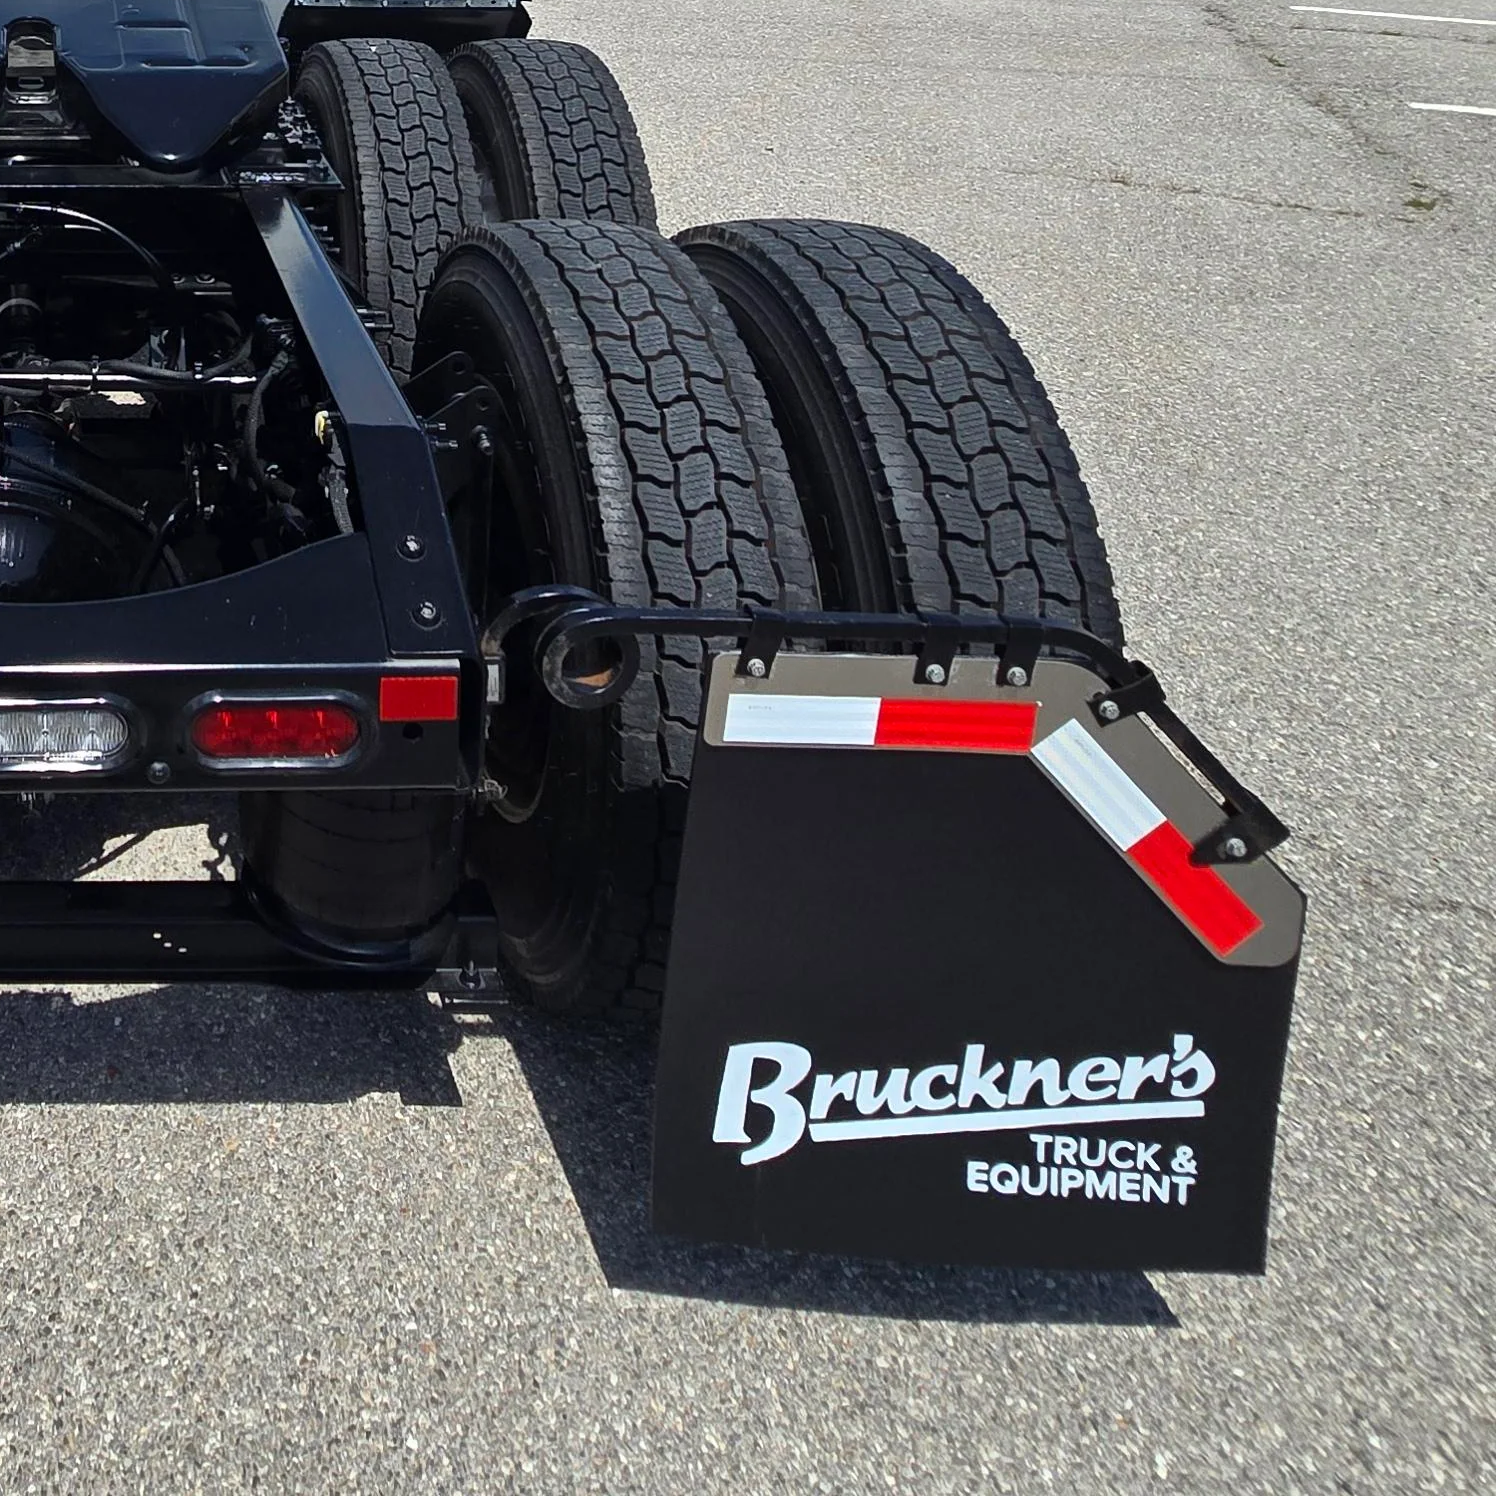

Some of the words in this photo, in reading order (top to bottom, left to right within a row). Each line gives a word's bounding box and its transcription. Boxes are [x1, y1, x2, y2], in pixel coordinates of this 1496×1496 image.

[712, 1033, 1216, 1166] Bruckner's
[1029, 1133, 1162, 1172] TRUCK
[1170, 1145, 1198, 1175] &
[966, 1160, 1196, 1206] EQUIPMENT
